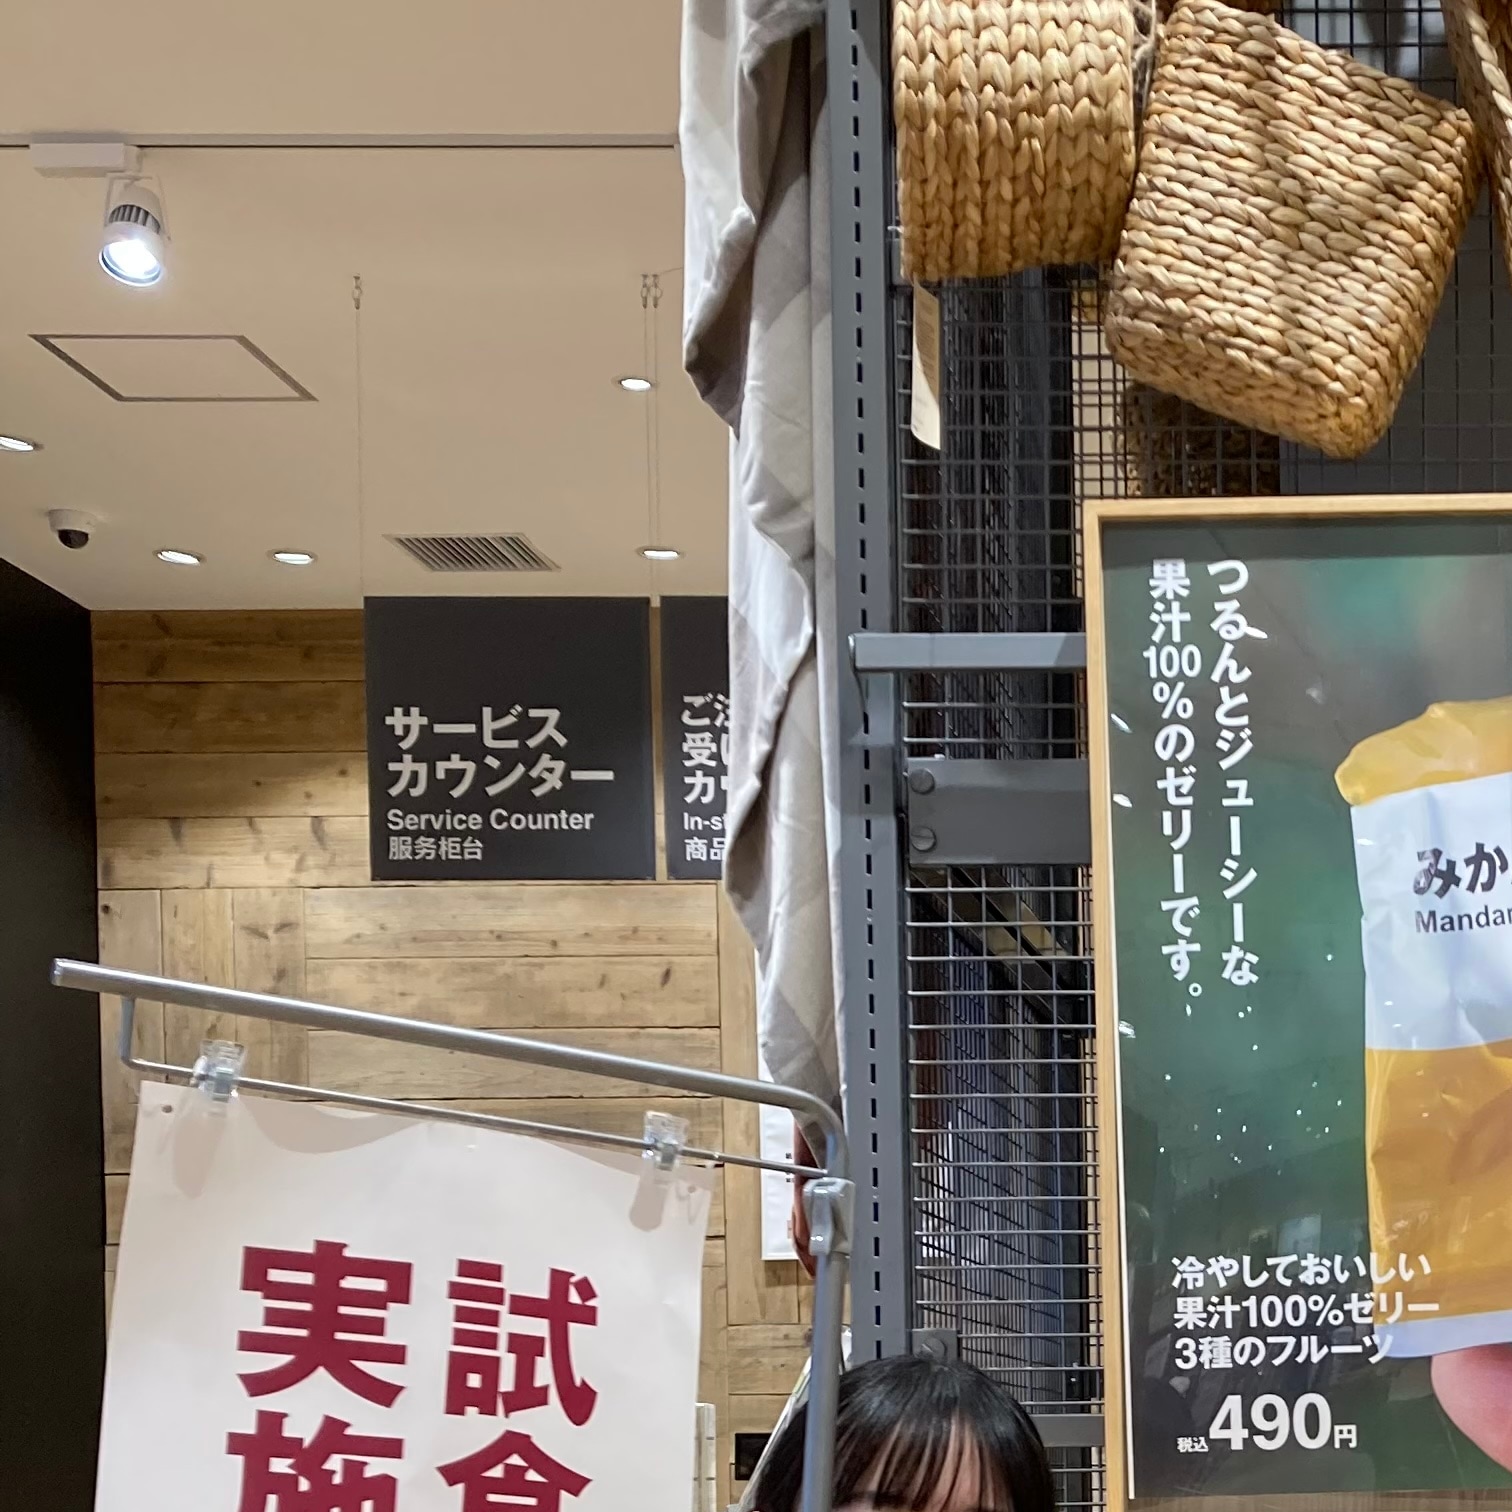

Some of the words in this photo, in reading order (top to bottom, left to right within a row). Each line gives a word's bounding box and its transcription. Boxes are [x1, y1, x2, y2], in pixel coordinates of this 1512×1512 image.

[385, 704, 568, 750] サービス
[387, 753, 615, 798] カウンター
[684, 770, 728, 804] カ
[1142, 559, 1203, 998] 果汁100%のゼリーです。
[1208, 561, 1260, 986] つるんとジューシーな
[387, 809, 482, 830] Service
[489, 809, 594, 830] Counter
[389, 837, 484, 861] 服务柜台
[1171, 1252, 1432, 1290] 冷やしておいしい
[1174, 1292, 1439, 1330] 果汁100%ゼリー
[1175, 1334, 1393, 1370] 3種のフルーツ
